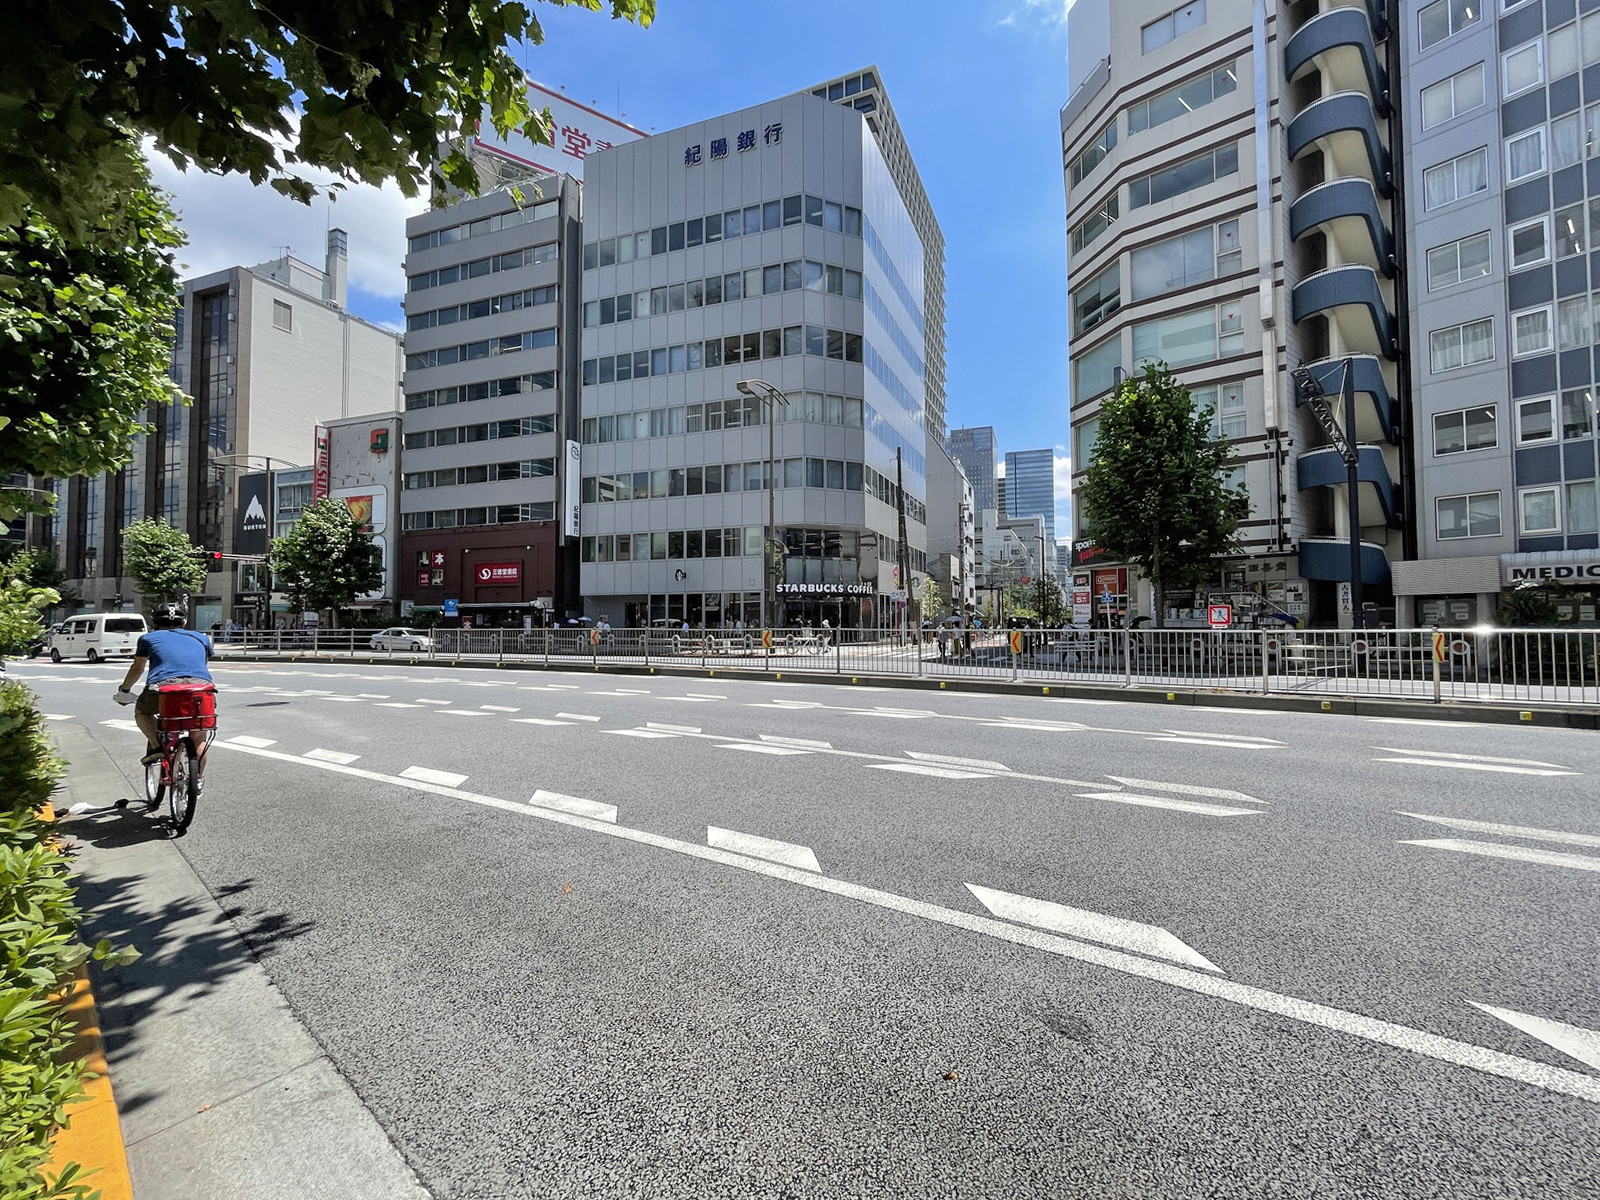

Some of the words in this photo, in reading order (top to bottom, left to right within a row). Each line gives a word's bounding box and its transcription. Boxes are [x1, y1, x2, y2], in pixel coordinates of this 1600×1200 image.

[684, 123, 783, 167] 紀陽銀行
[434, 552, 445, 565] 本
[776, 583, 844, 593] STARBUCKS
[847, 584, 873, 594] COFFEE
